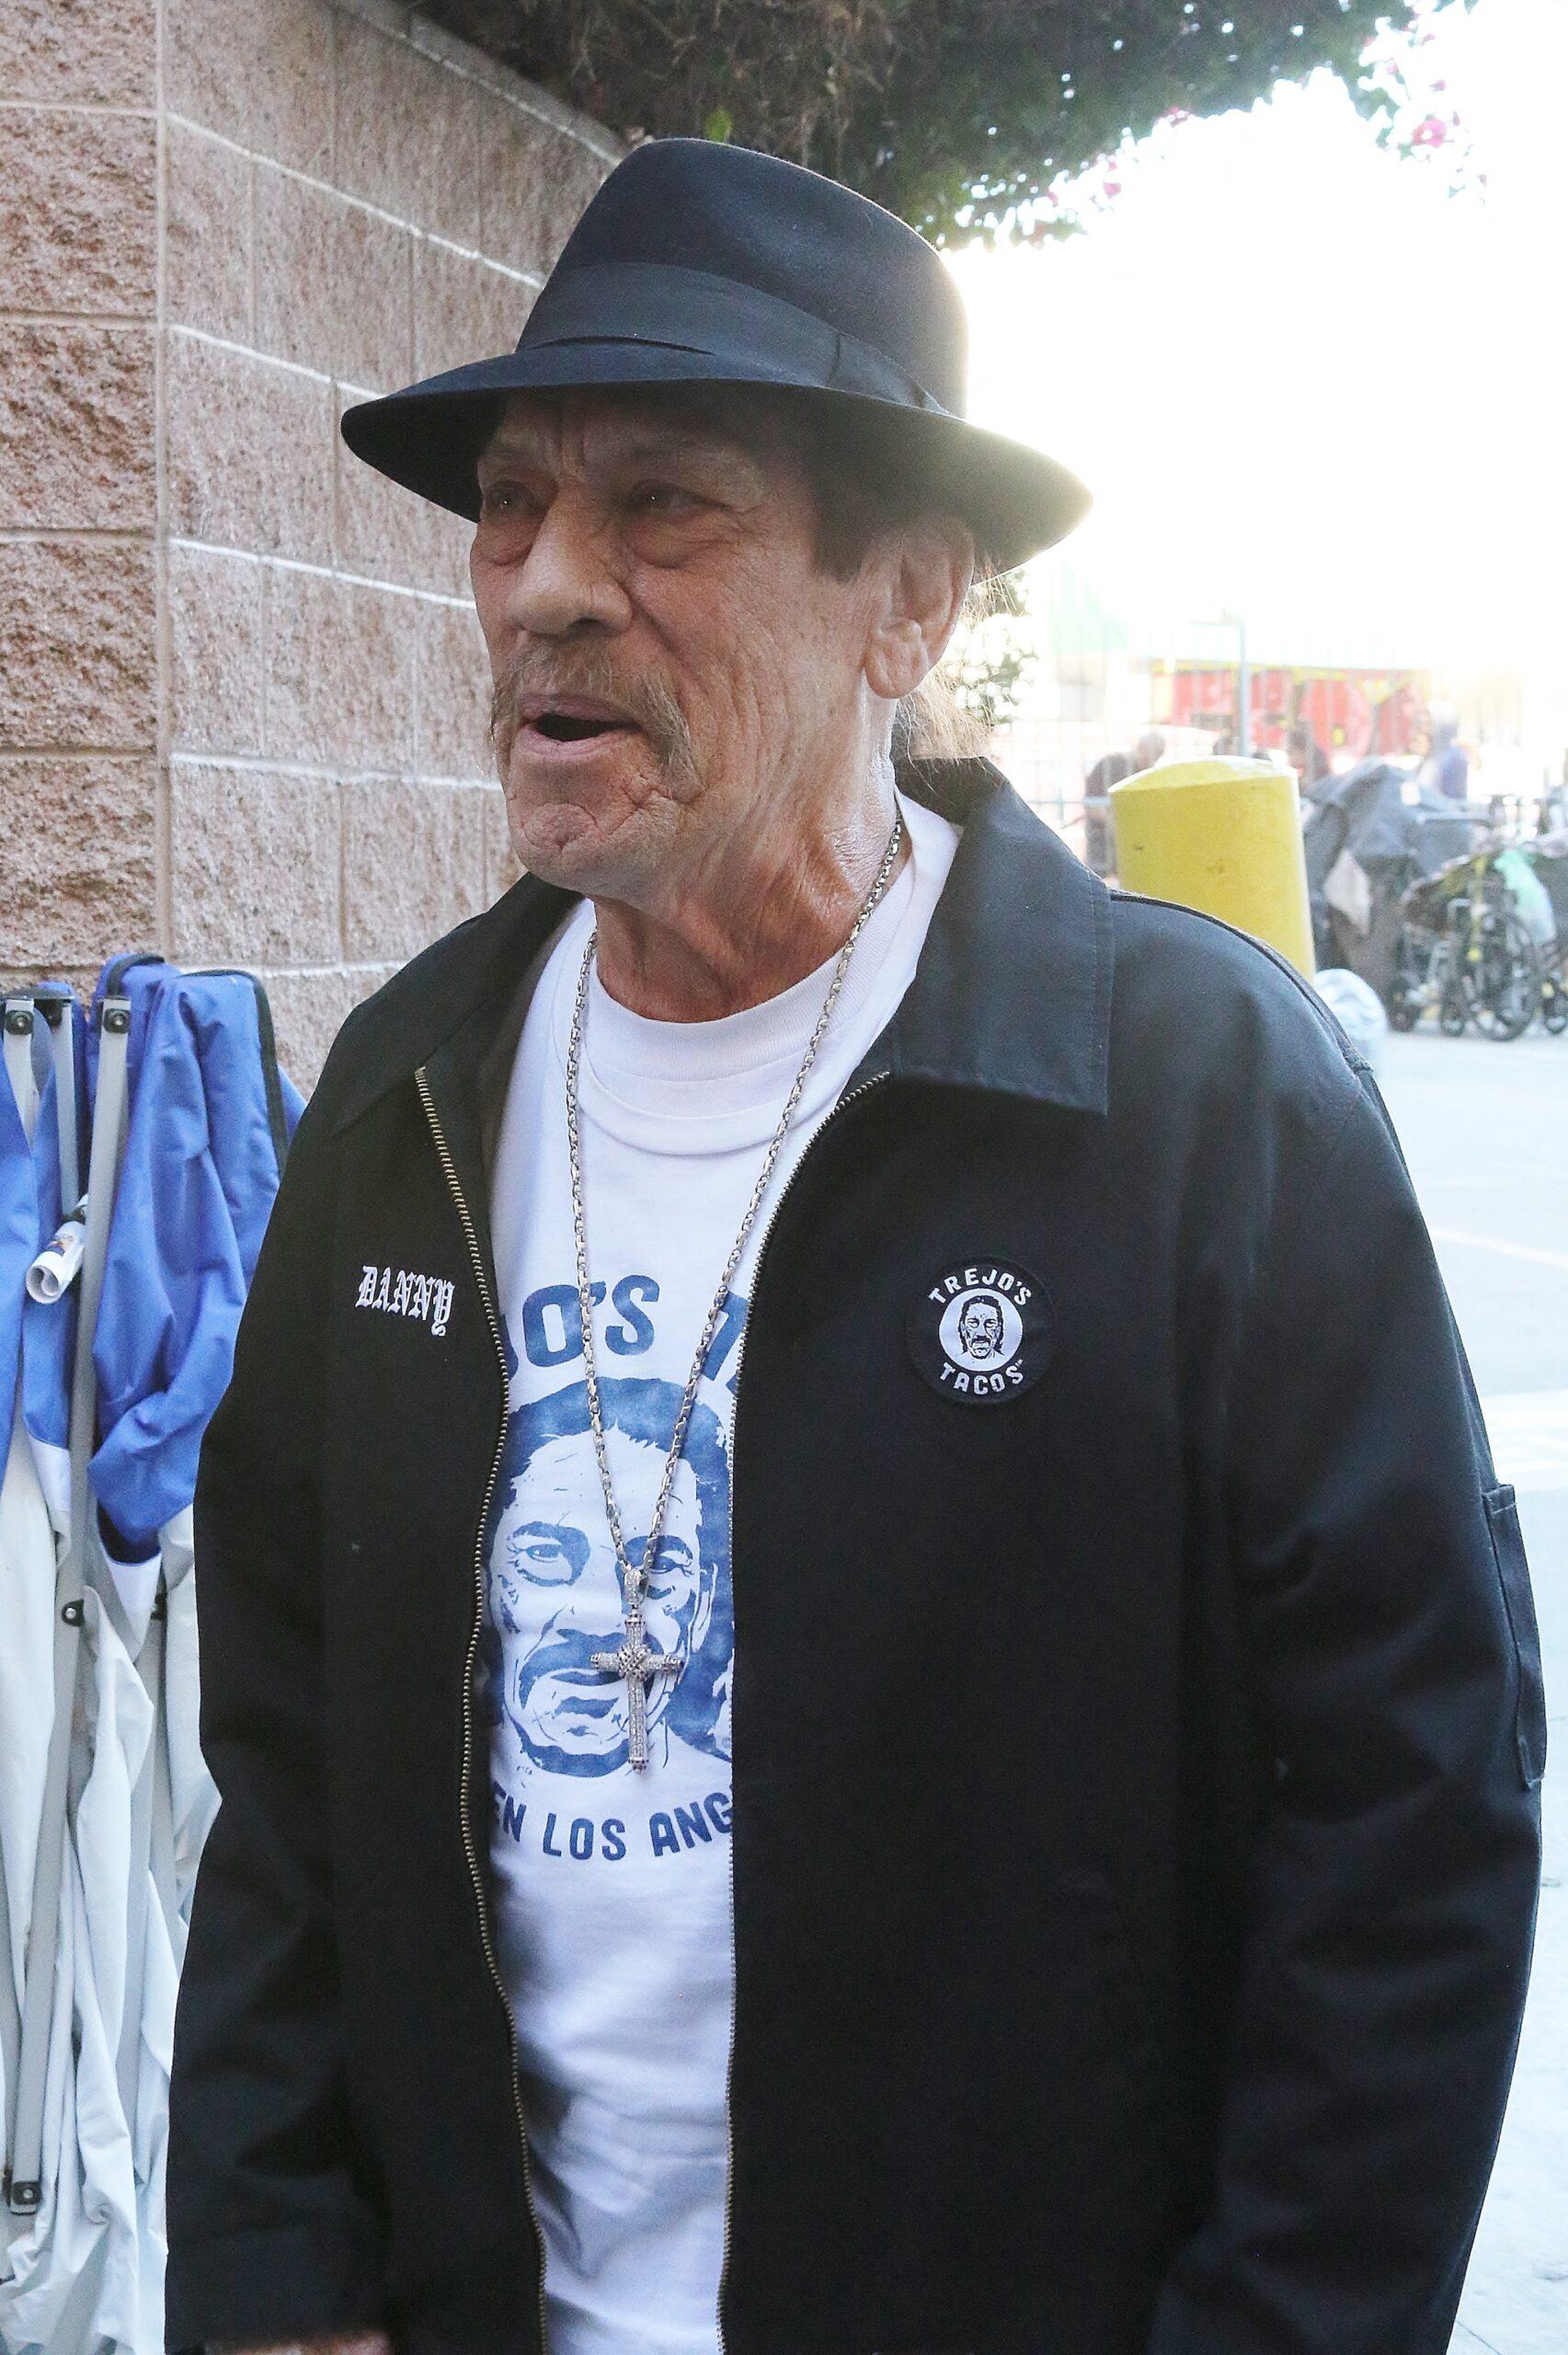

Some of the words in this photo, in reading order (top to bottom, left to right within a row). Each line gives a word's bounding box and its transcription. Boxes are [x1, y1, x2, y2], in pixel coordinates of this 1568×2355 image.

[355, 1265, 455, 1337] DANNY
[928, 1268, 1032, 1305] TREJO'S
[500, 1274, 660, 1380] O'S
[543, 1813, 626, 1861] LOS
